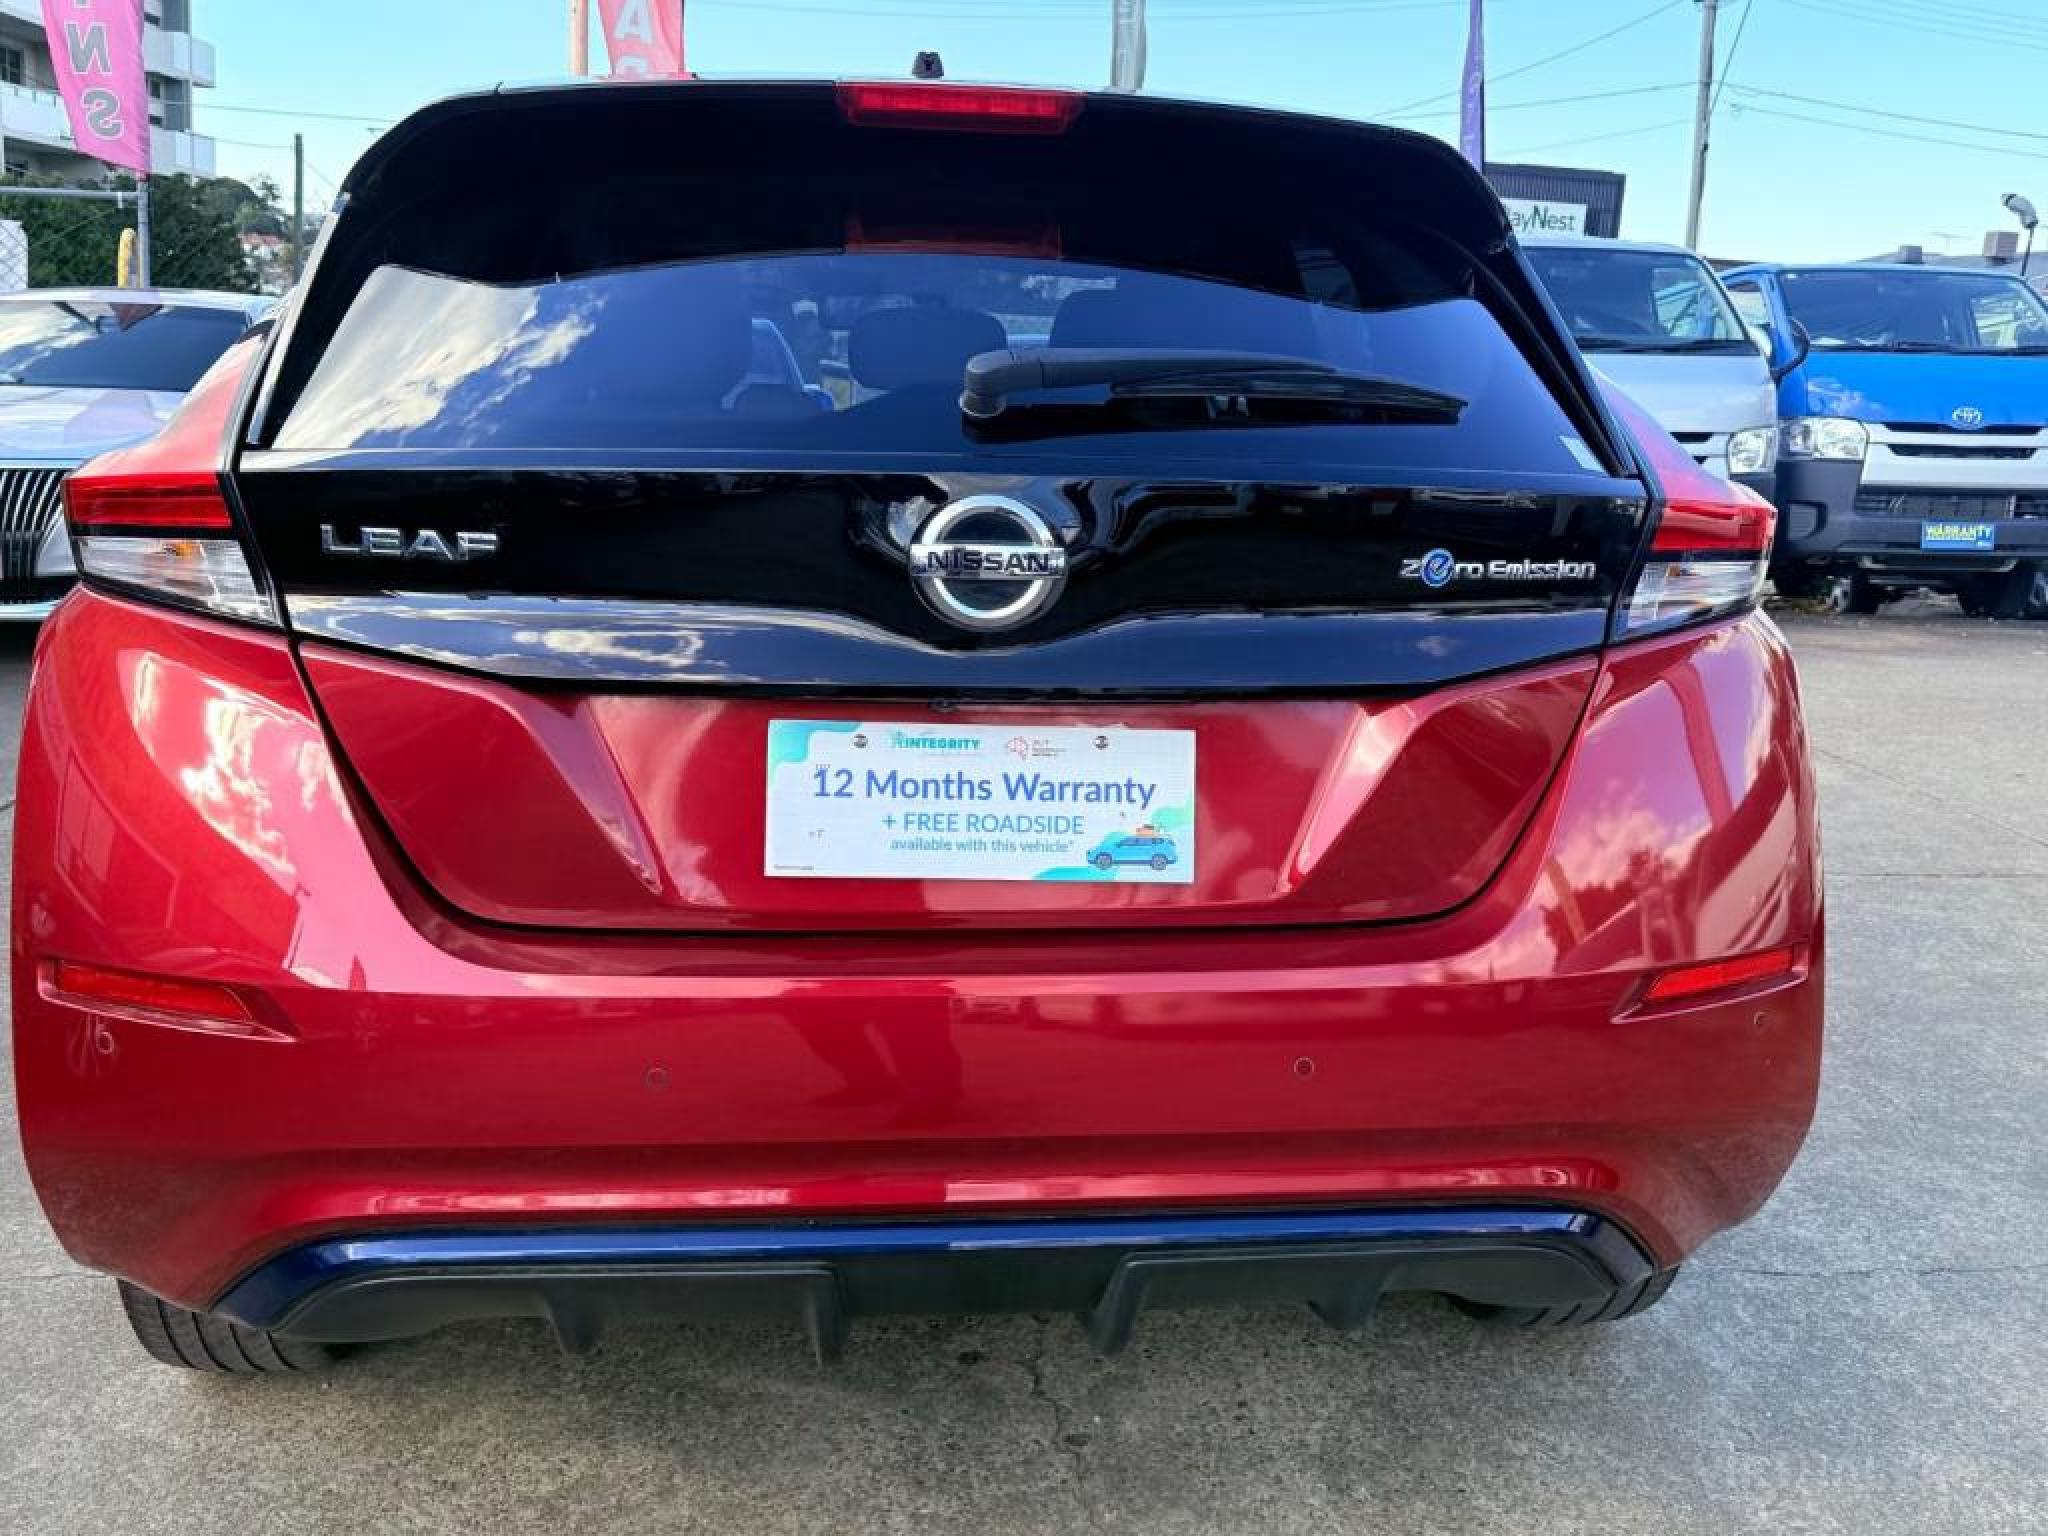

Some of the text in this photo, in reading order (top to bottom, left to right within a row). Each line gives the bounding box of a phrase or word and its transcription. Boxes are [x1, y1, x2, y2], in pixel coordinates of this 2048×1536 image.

[320, 523, 497, 560] LEAF
[926, 547, 1049, 572] NISSAN
[1487, 557, 1596, 579] Emission
[903, 737, 981, 750] INTEGRITY
[813, 767, 1157, 811] 12 Months Warranty
[903, 812, 959, 833] FREE
[966, 813, 1085, 835] ROADSIDE
[889, 836, 953, 851] available
[955, 838, 987, 852] with
[991, 838, 1017, 853] this
